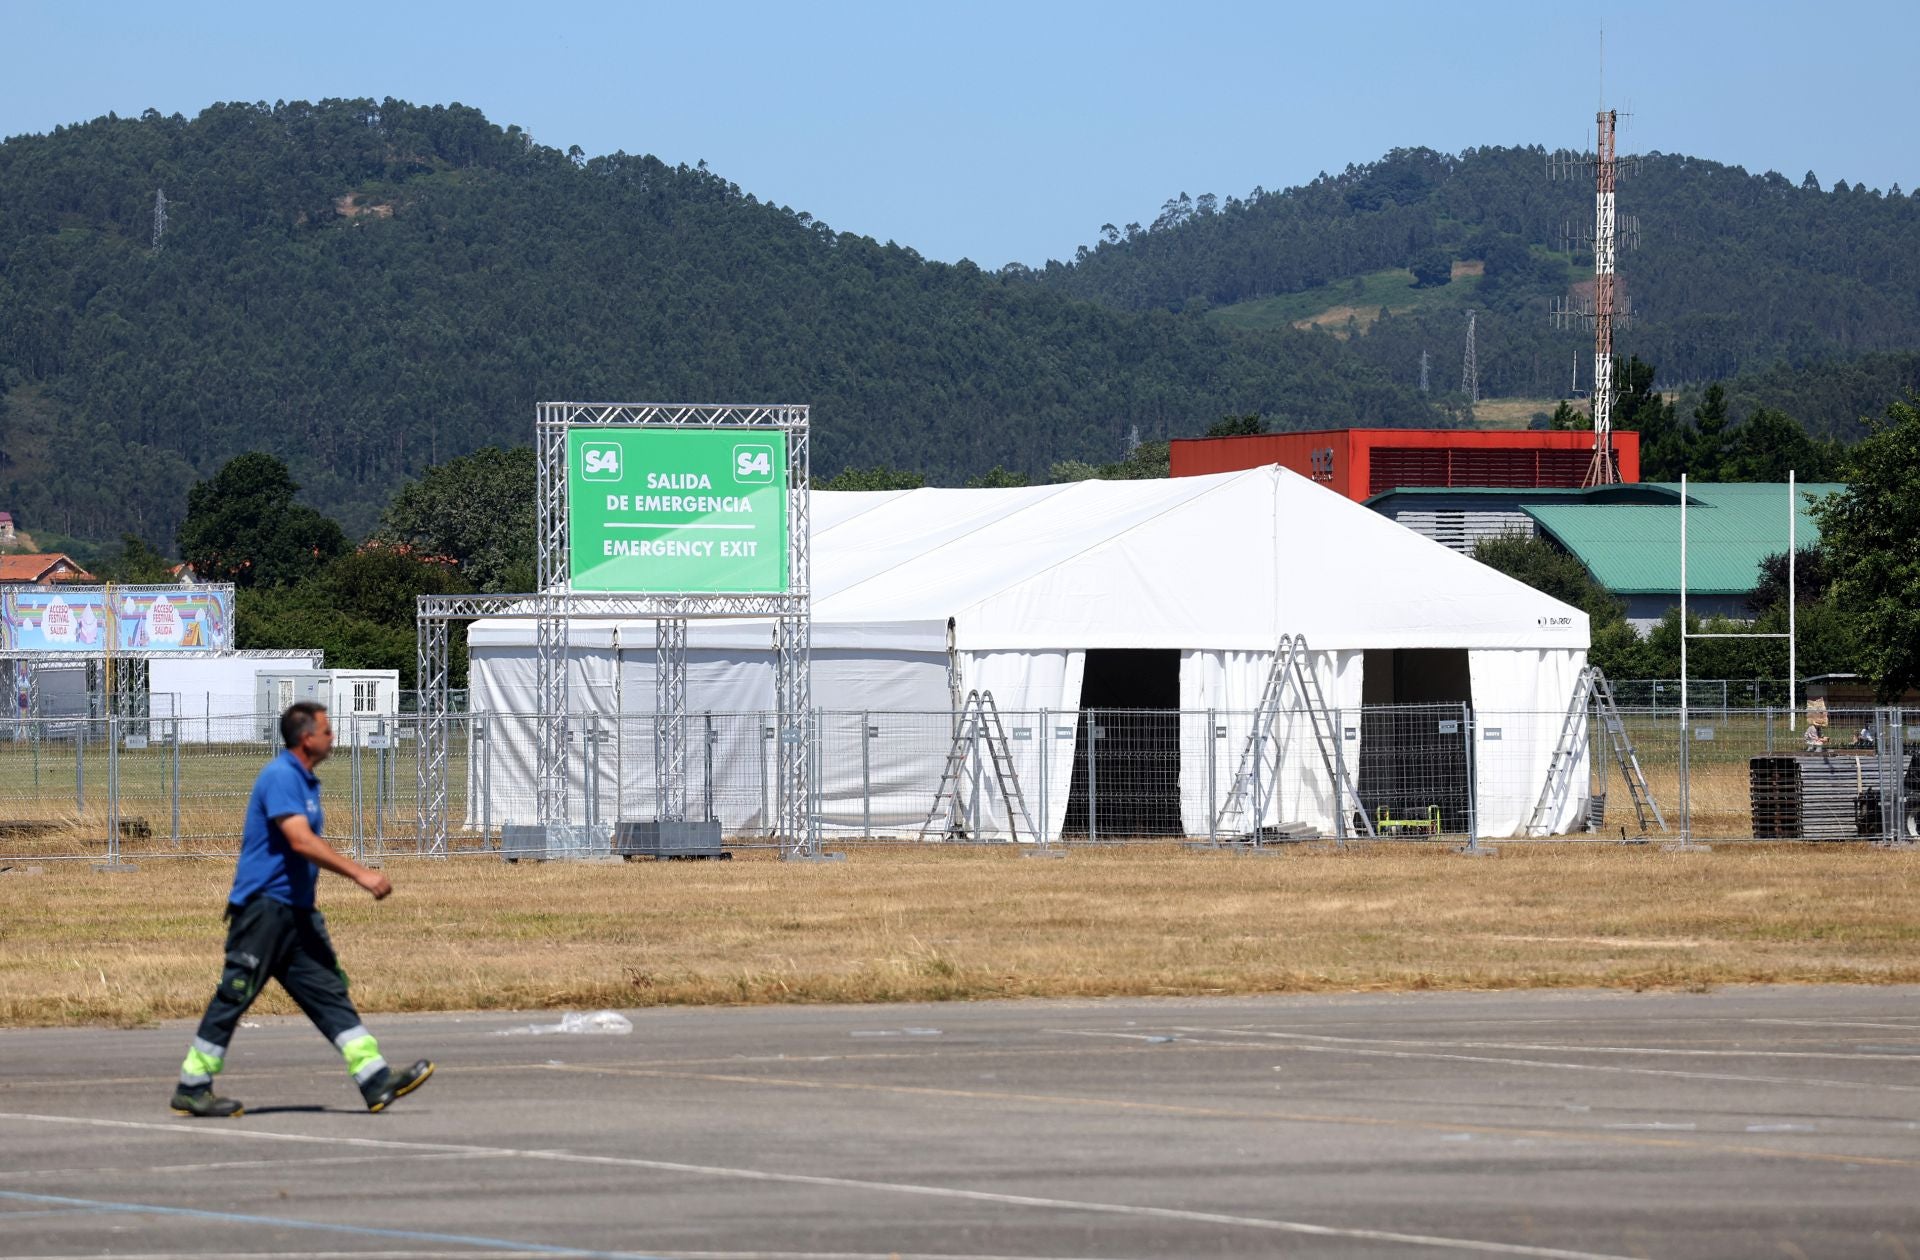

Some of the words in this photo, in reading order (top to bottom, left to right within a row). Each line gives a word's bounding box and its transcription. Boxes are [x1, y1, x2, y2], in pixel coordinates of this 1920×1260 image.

[585, 449, 619, 474] S4
[737, 452, 771, 476] S4
[646, 472, 712, 490] SALIDA
[606, 494, 629, 511] DE
[635, 495, 753, 513] EMERGENCIA
[603, 539, 714, 557] EMERGENCY
[719, 540, 758, 557] EXIT
[49, 604, 69, 614] ACCESO
[153, 604, 174, 614] ACCESO
[48, 614, 70, 623] FESTIVAL
[152, 614, 175, 623] FESTIVAL
[49, 626, 68, 635] SALIDA
[154, 626, 173, 635] SALIDA
